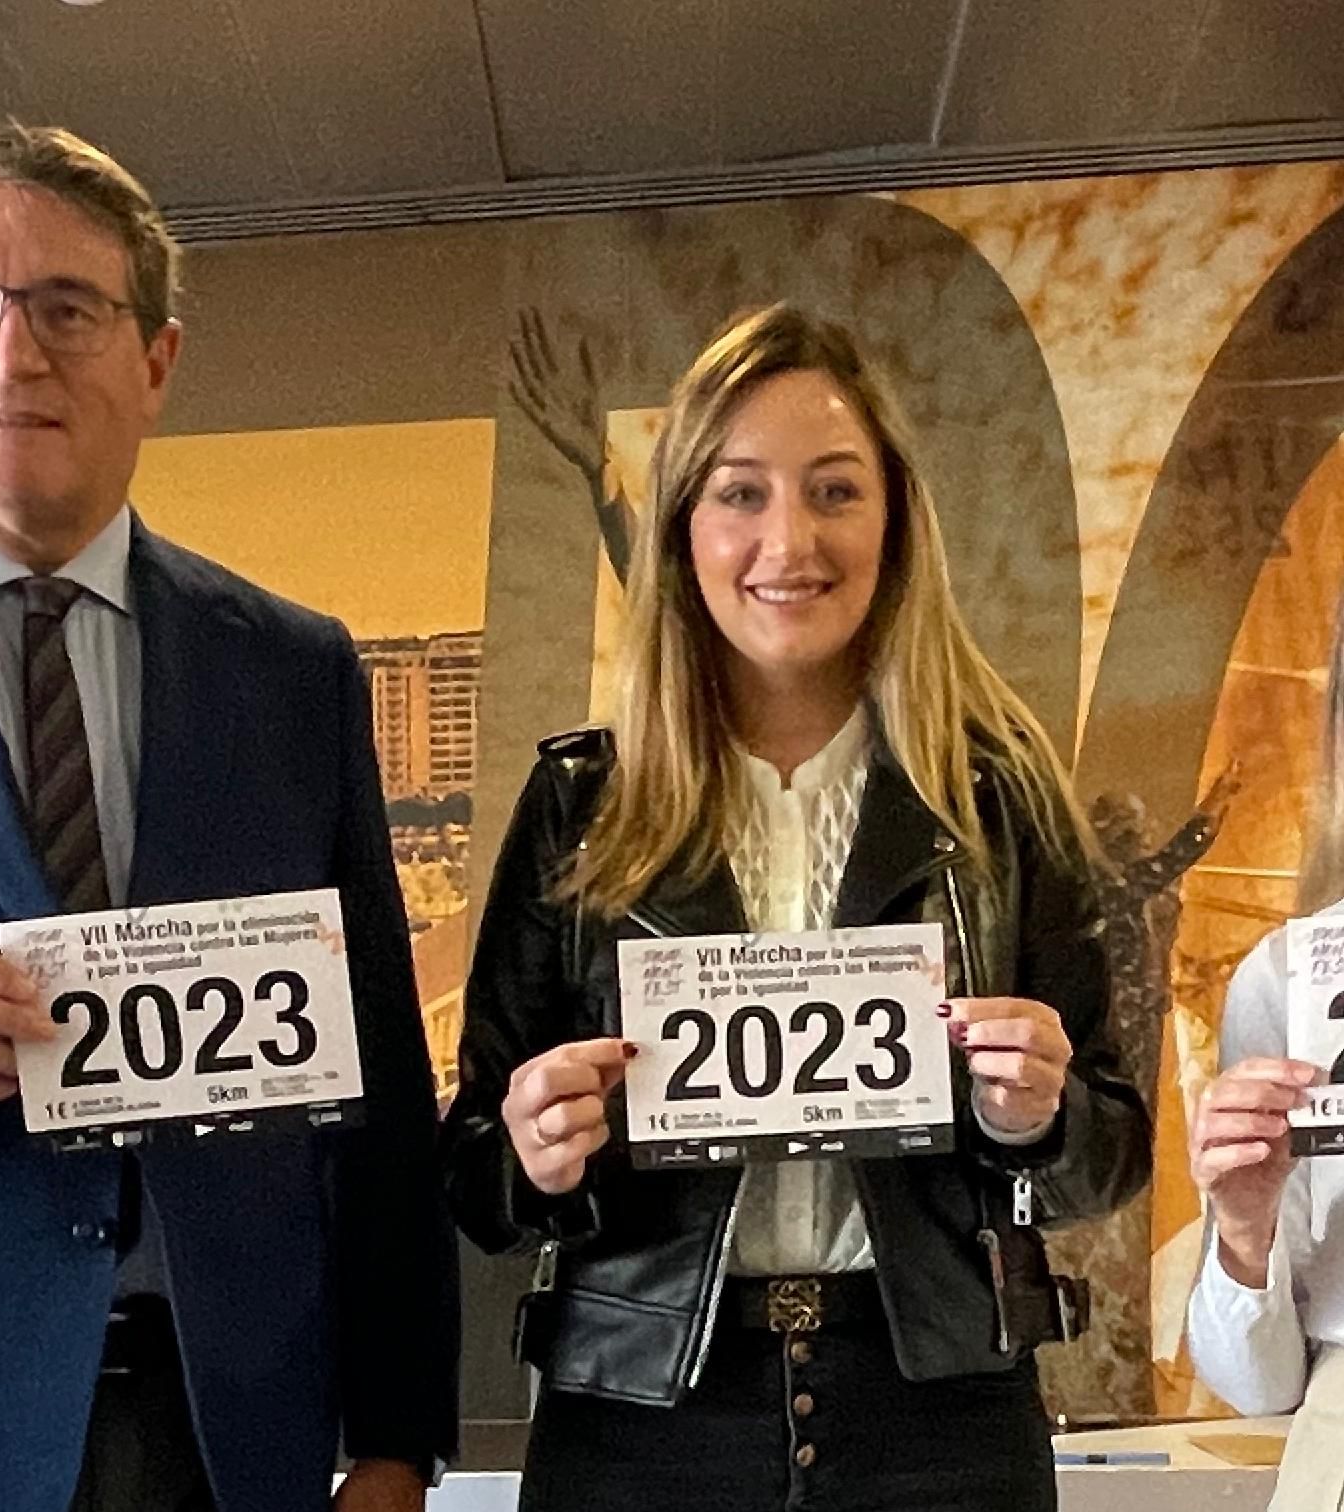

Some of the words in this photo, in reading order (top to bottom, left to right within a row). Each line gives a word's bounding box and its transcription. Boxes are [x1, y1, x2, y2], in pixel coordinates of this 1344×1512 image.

[80, 924, 108, 946] VII
[115, 918, 192, 942] Marcha
[696, 947, 722, 967] VII
[729, 944, 802, 965] Marcha
[50, 970, 318, 1089] 2023
[661, 998, 912, 1102] 2023
[206, 1085, 249, 1104] 5km
[802, 1105, 843, 1123] 5km
